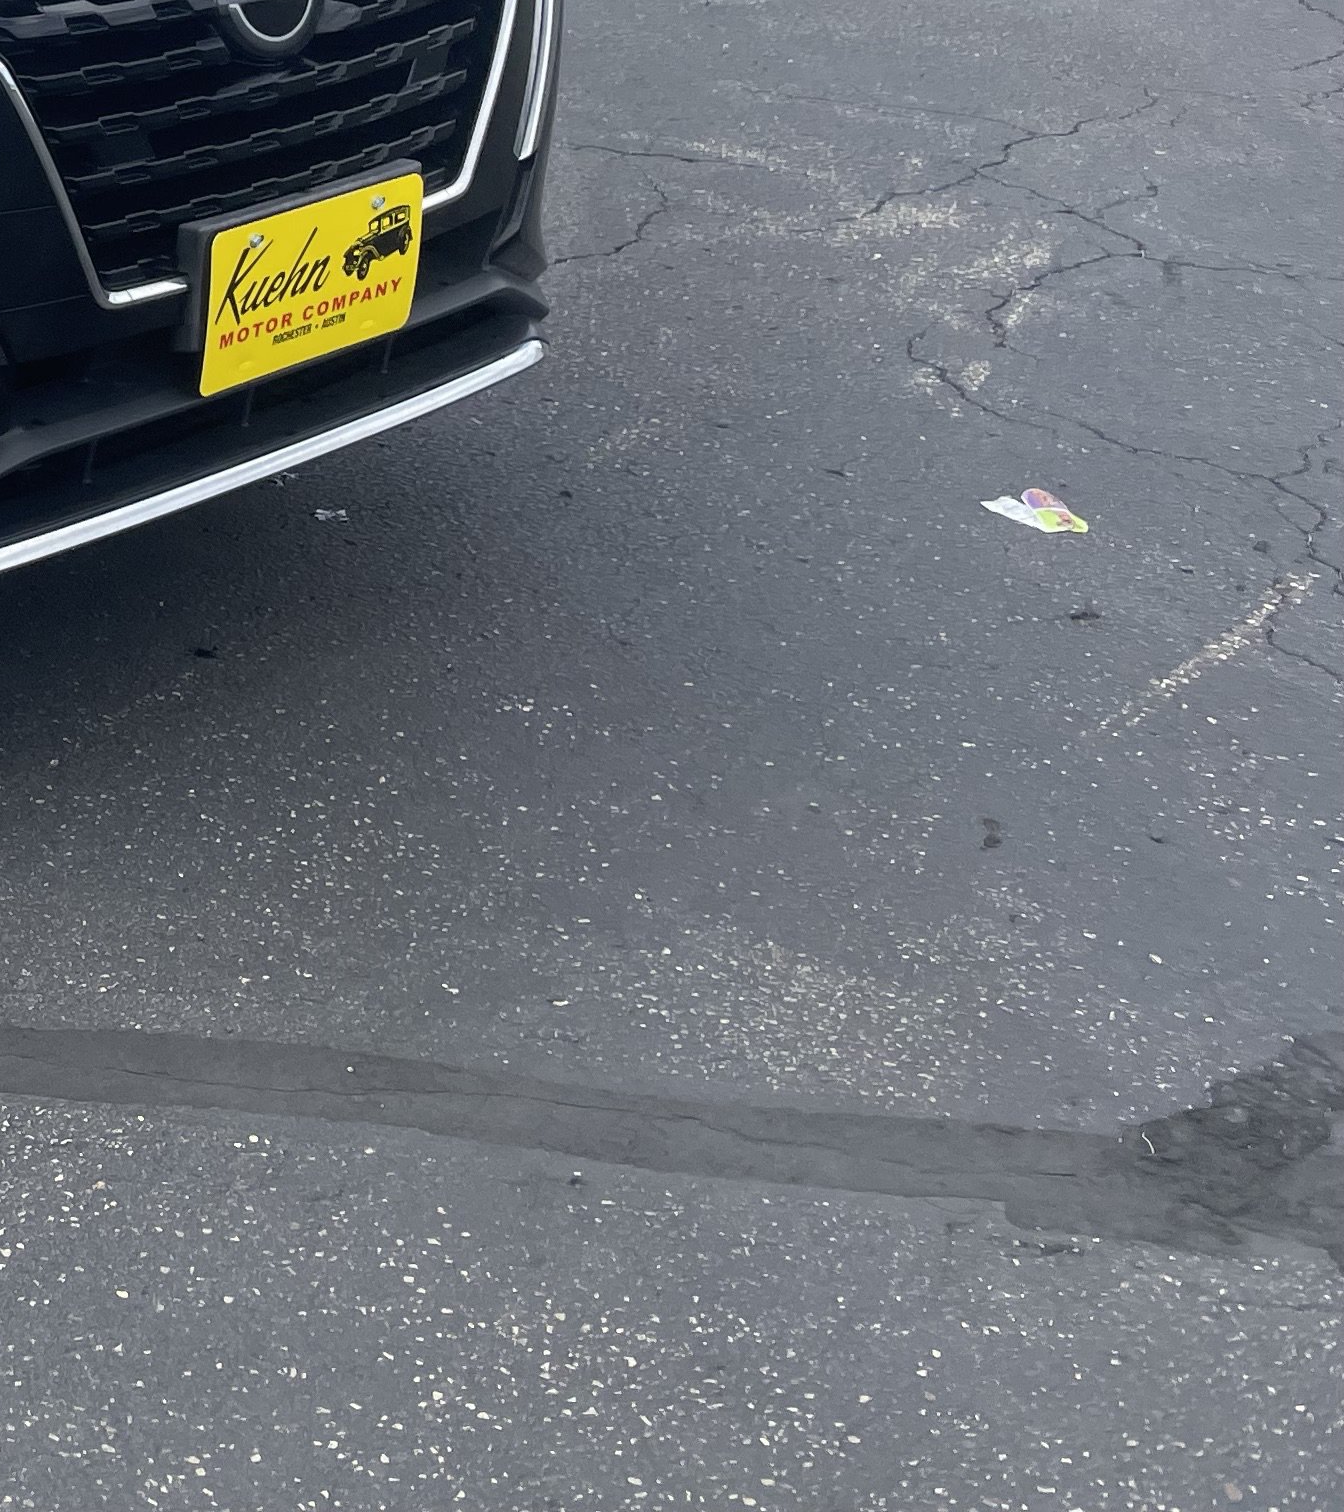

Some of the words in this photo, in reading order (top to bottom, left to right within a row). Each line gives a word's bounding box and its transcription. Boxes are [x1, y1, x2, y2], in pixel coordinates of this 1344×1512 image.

[214, 227, 330, 325] Kuehn
[219, 312, 292, 349] MOTOR
[302, 277, 402, 321] COMPANY
